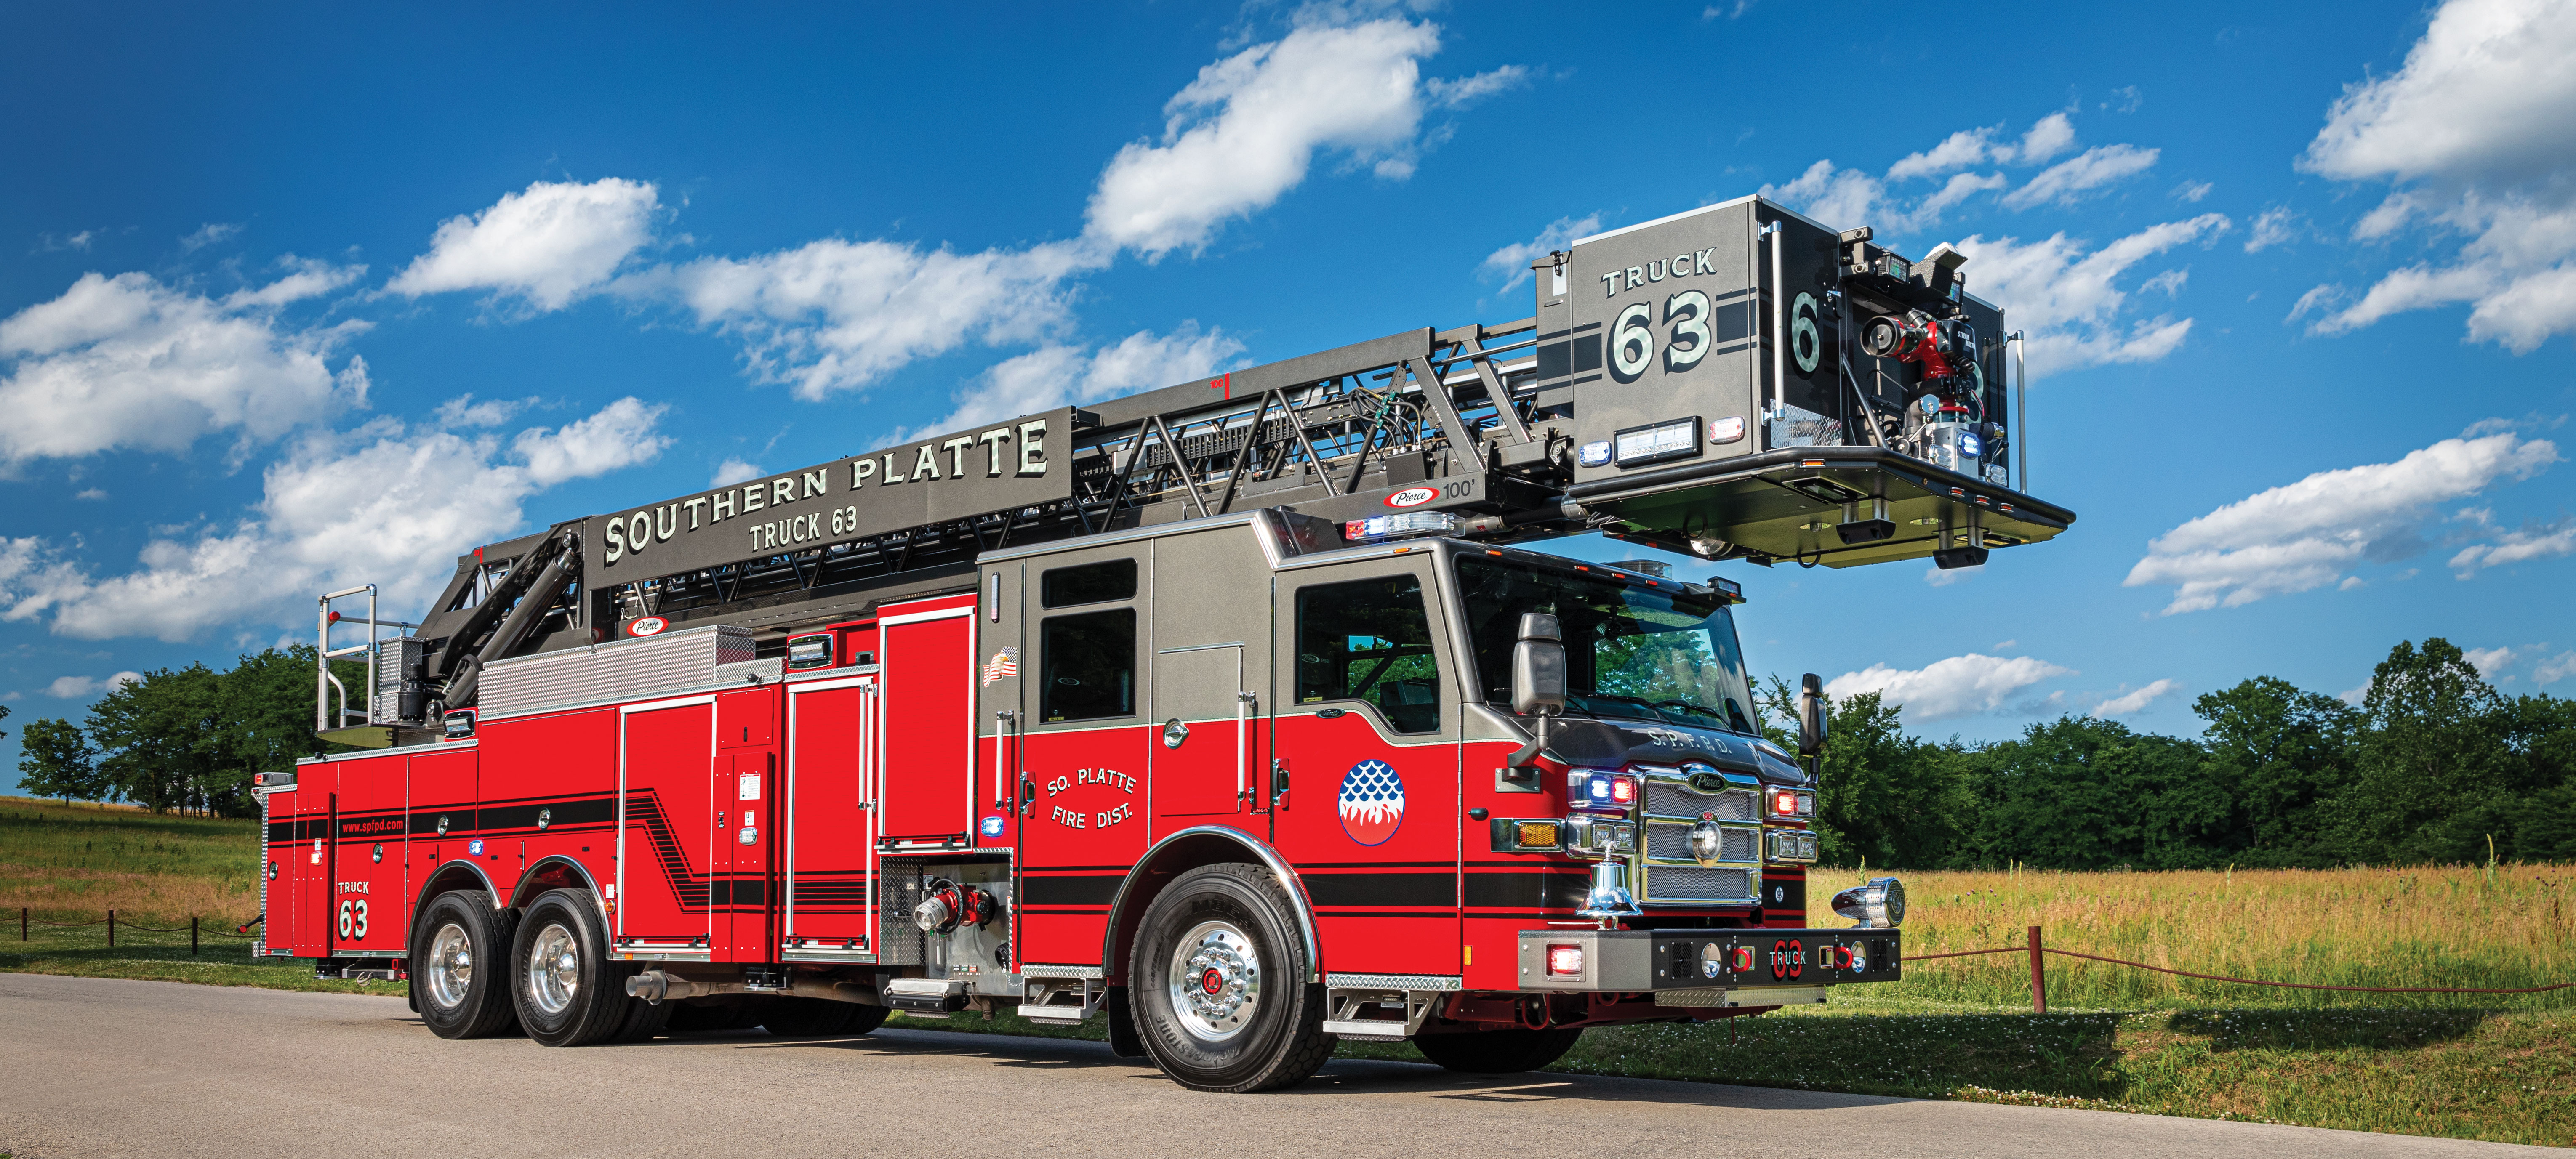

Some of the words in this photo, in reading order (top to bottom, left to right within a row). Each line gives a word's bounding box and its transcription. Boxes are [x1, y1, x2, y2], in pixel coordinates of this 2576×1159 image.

[1601, 247, 1717, 298] TRUCK
[1607, 290, 1712, 384] 63
[1788, 290, 1819, 380] 6
[1958, 331, 1969, 340] STREAM
[1210, 378, 1223, 389] 100
[605, 468, 828, 568] SOUTHERN
[849, 418, 1048, 491] PLATTE
[1396, 492, 1426, 505] Pierce
[749, 512, 821, 552] TRUCK
[831, 505, 857, 537] 63
[637, 621, 659, 633] Pierce
[1647, 730, 1732, 754] S.P.F.P.D.
[1047, 776, 1071, 797] SO.
[1078, 768, 1136, 794] PLATTE
[1697, 774, 1721, 788] Pierce
[343, 819, 403, 834] www.spfpd.com
[1051, 805, 1085, 829] FIRE
[1097, 802, 1133, 829] DIST.
[338, 881, 369, 895] TRUCK
[339, 899, 368, 941] 63
[1769, 951, 1806, 965] TRUCK
[1772, 939, 1802, 981] 63
